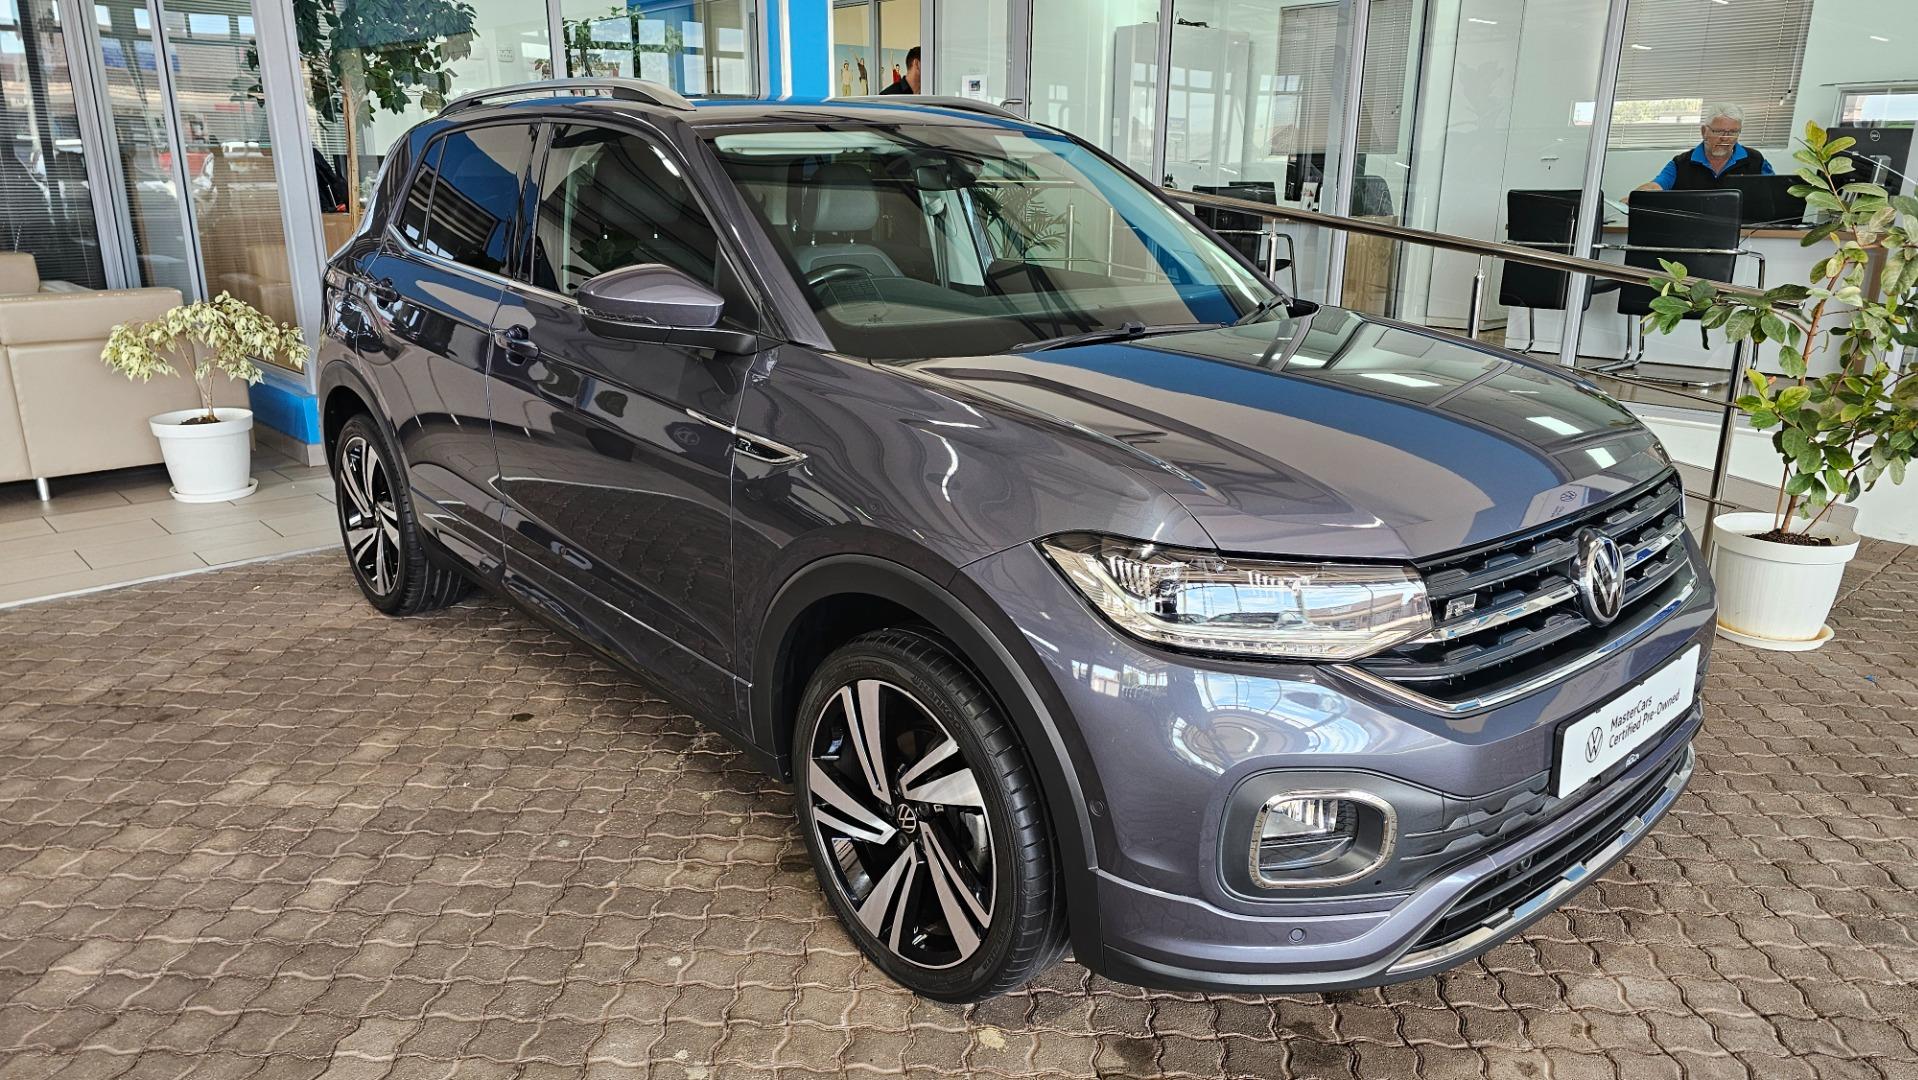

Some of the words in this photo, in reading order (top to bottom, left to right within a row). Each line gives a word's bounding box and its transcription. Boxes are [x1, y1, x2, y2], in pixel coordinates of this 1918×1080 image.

[1609, 715, 1641, 748] Certified
[1643, 688, 1681, 726] Pre-Owned
[1610, 696, 1653, 732] MasterCars
